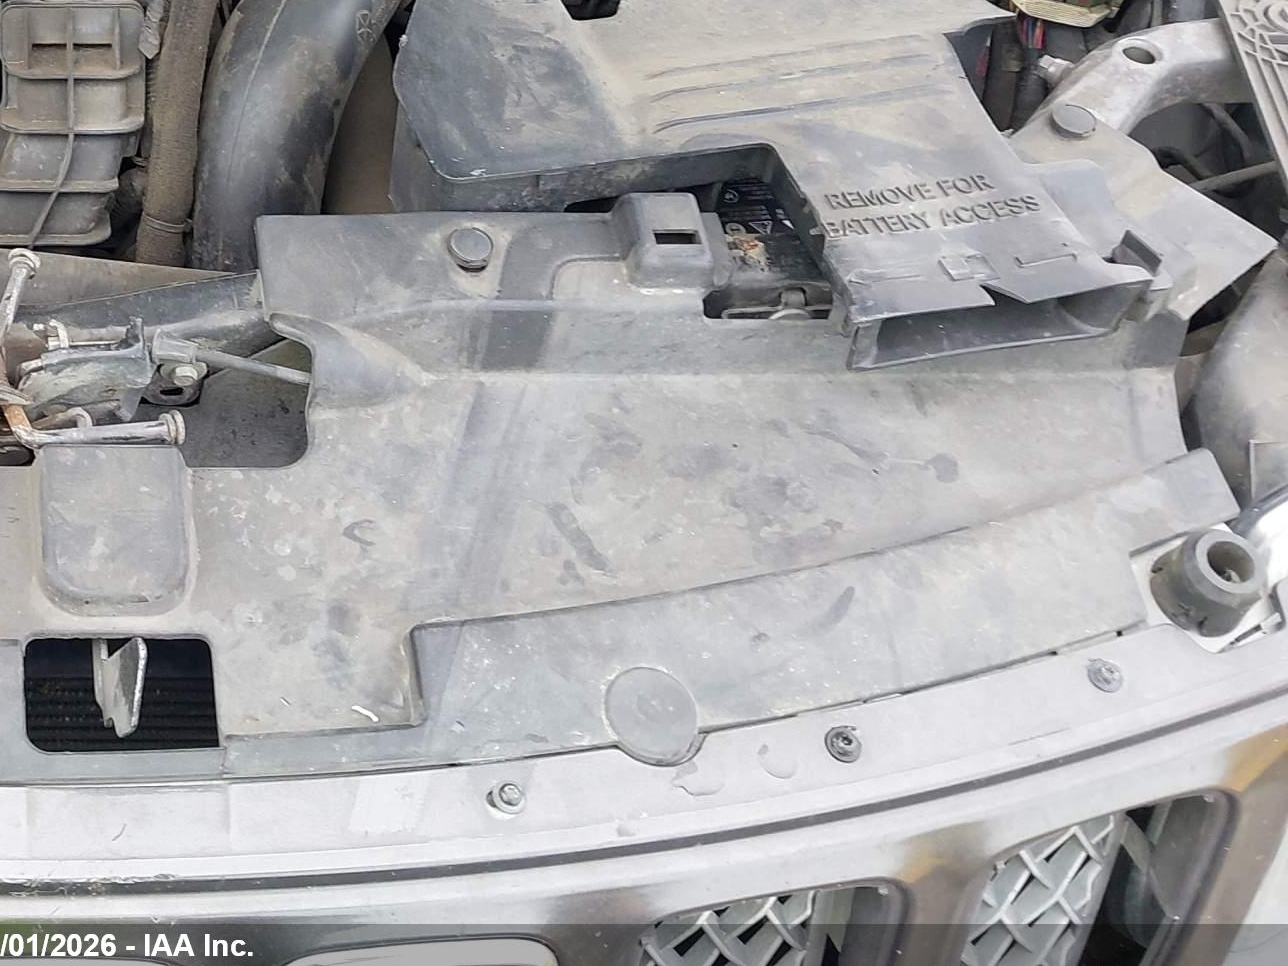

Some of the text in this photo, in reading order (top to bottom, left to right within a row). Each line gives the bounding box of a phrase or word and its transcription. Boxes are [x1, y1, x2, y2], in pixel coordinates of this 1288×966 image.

[824, 174, 996, 212] REMOVE FOR
[823, 195, 1042, 239] BATTERY ACCESS
